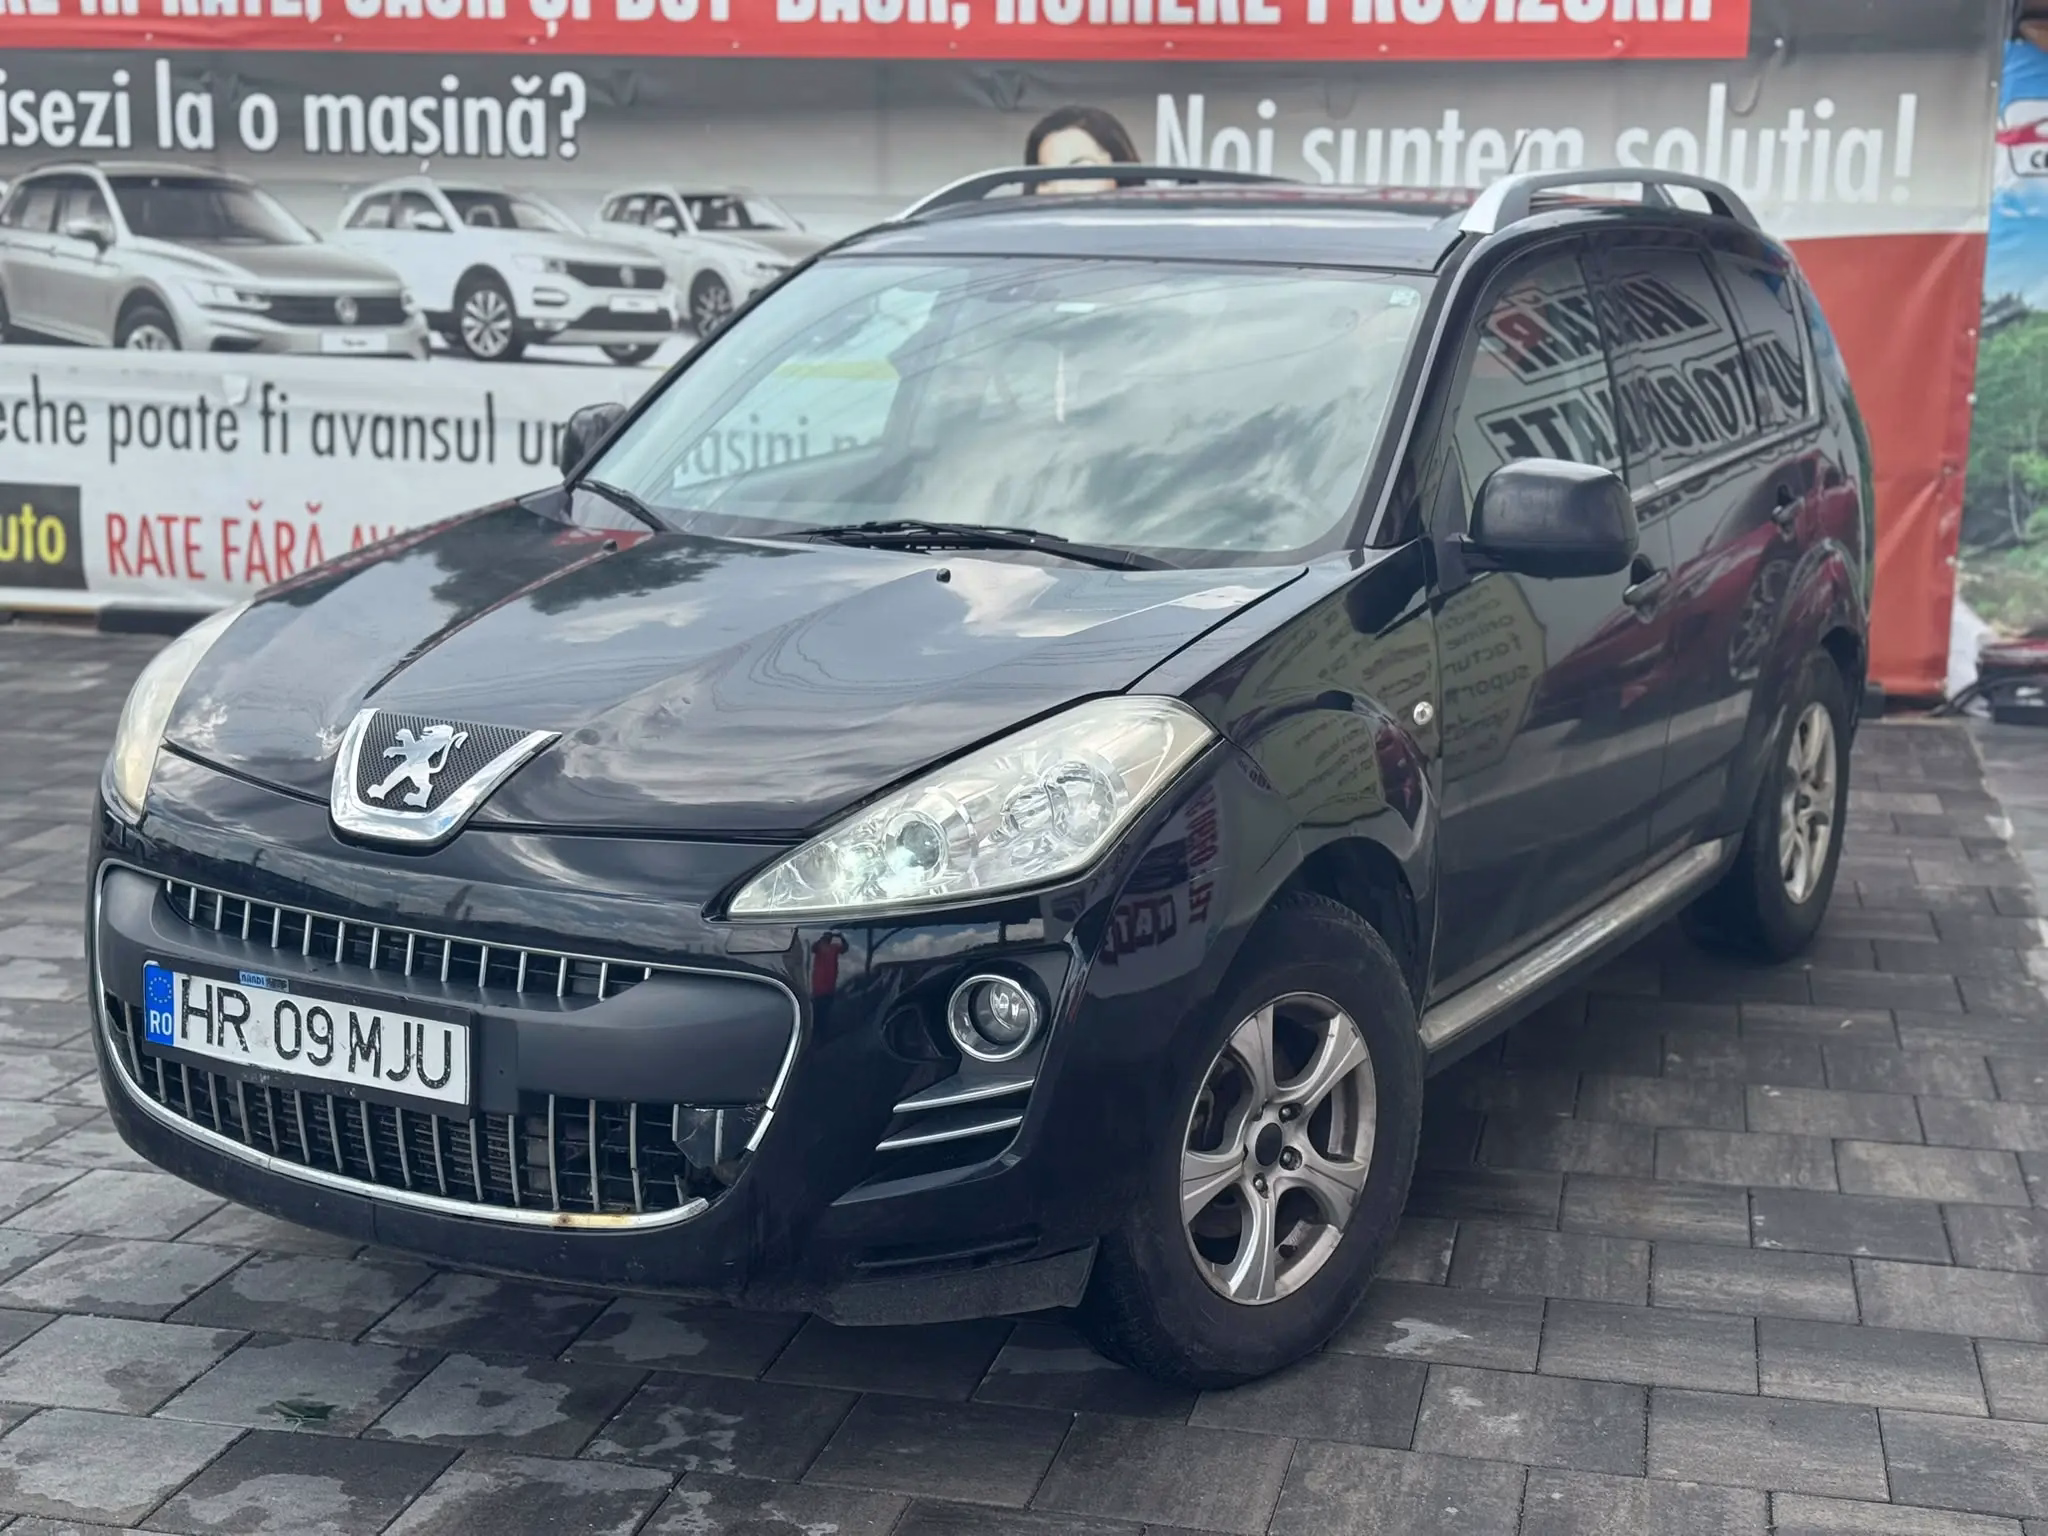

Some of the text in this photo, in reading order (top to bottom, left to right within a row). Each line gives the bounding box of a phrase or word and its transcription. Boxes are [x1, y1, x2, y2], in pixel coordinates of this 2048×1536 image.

[156, 58, 214, 149] la
[239, 93, 279, 151] o
[1156, 94, 1274, 175] Noi
[1302, 109, 1584, 188] suntem
[109, 394, 238, 464] poate
[261, 382, 289, 455] fi
[311, 391, 495, 465] avansul
[106, 500, 325, 584] RATE FĂRĂ
[149, 1009, 172, 1037] RO
[181, 977, 453, 1090] HR 09 MJU
